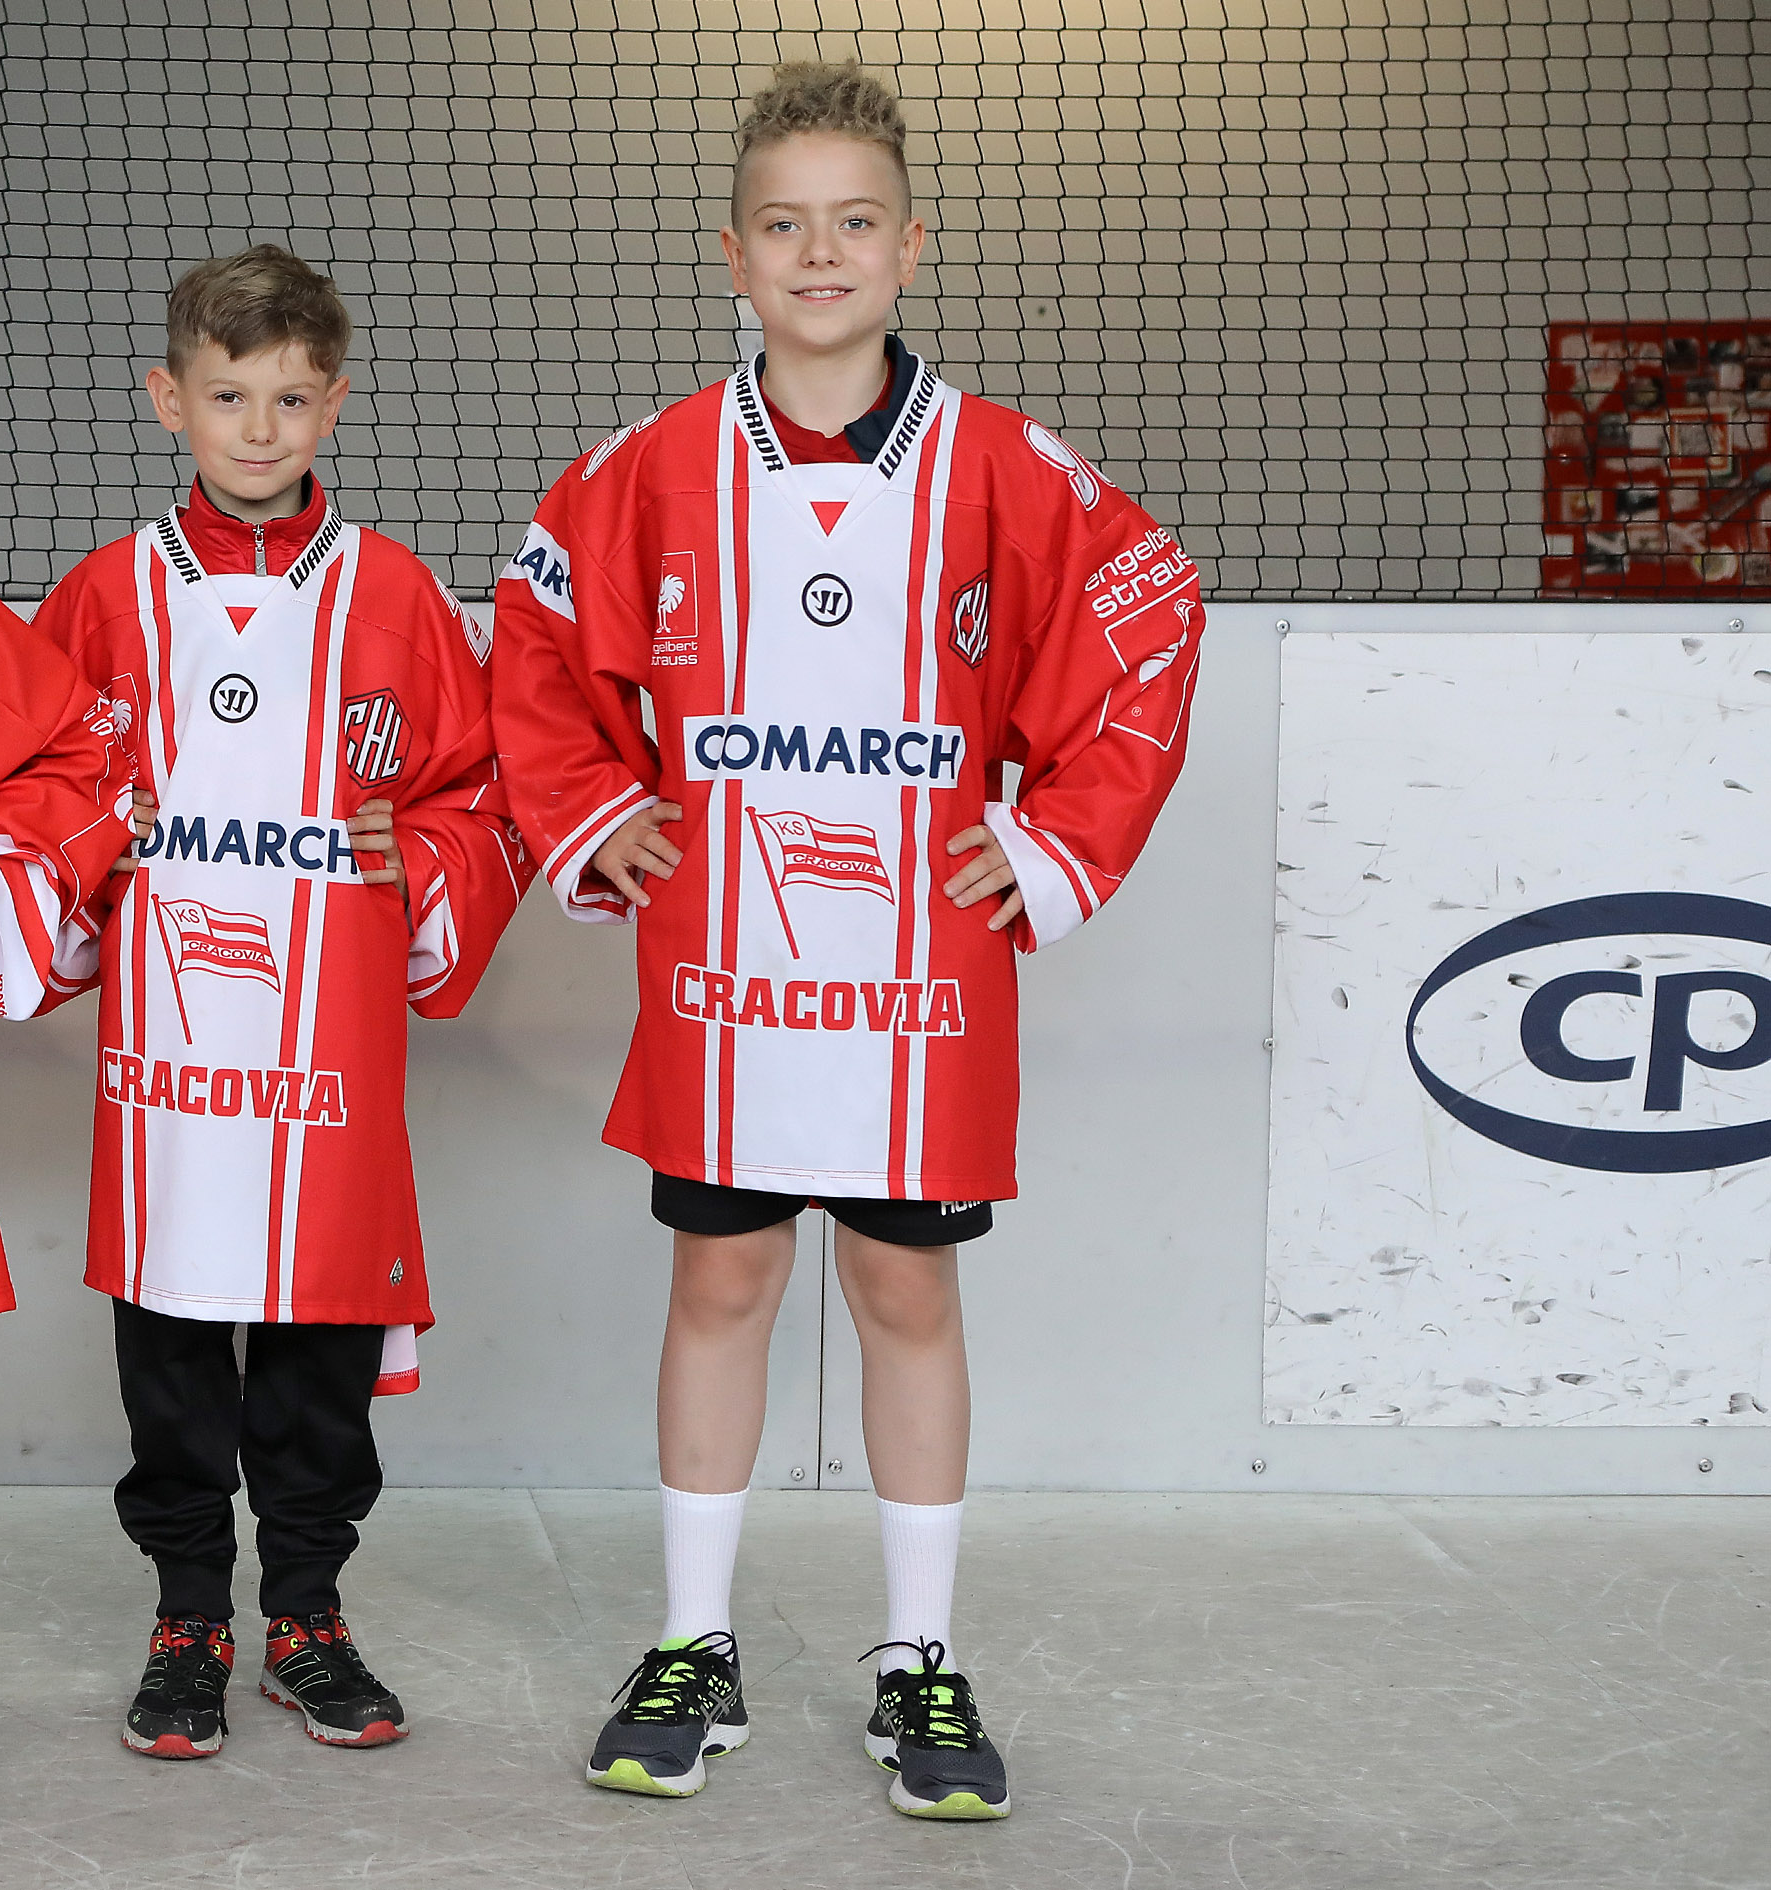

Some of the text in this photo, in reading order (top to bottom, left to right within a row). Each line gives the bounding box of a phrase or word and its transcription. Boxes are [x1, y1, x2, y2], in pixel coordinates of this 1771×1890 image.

[156, 512, 203, 586] ARRIOR
[344, 694, 403, 782] CHL
[693, 723, 963, 781] COMARCH
[776, 820, 805, 836] KS
[792, 853, 878, 875] CRACOVIA
[175, 908, 201, 924] KS
[188, 940, 267, 963] CRACOVIA
[672, 962, 966, 1036] CRACOVIA
[103, 1047, 347, 1127] CRACOVIA
